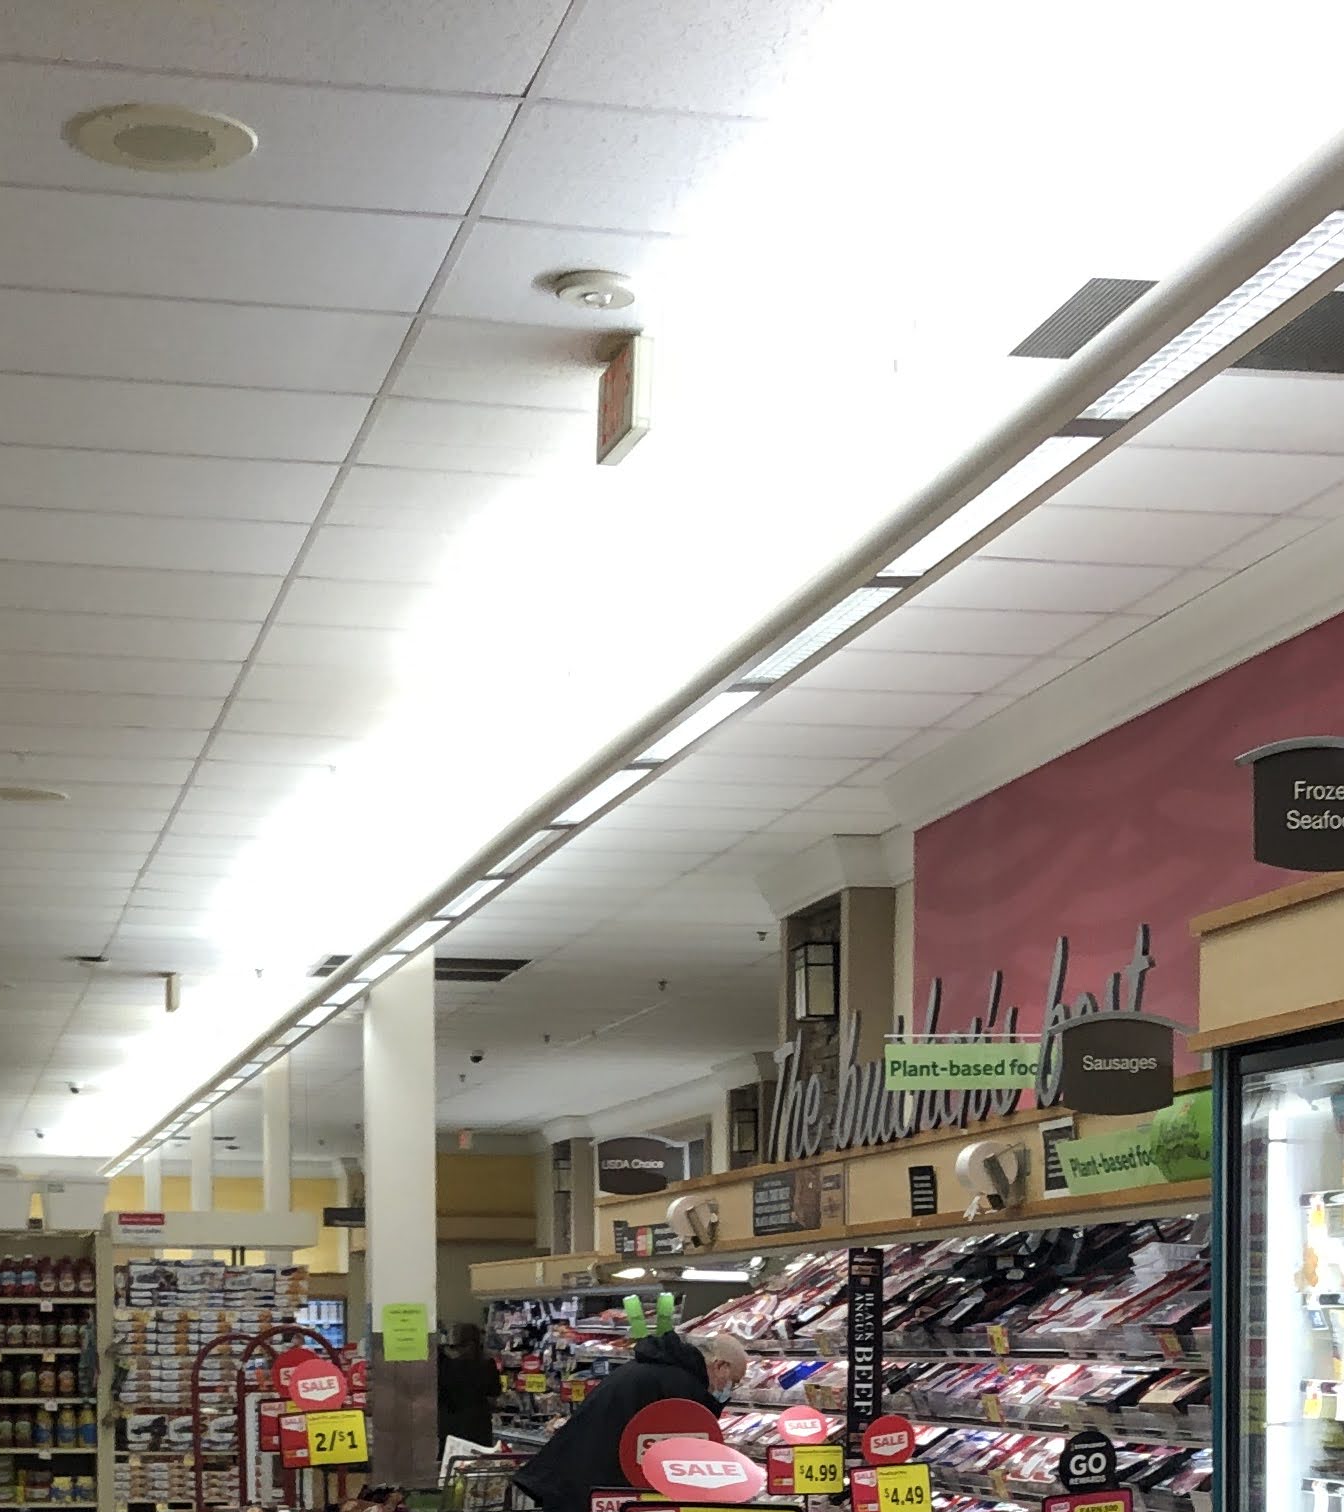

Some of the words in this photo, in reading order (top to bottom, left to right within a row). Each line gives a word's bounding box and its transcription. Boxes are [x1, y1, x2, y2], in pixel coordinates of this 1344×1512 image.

[890, 1059, 1005, 1077] Plant-based
[1009, 1059, 1040, 1077] foo
[1083, 1055, 1157, 1073] Sausages
[768, 1029, 823, 1162] The
[601, 1160, 630, 1169] USDA
[631, 1159, 665, 1169] Choice
[1070, 1146, 1137, 1177] Plant-based
[854, 1293, 864, 1341] ANGUS
[301, 1379, 336, 1392] SALE
[854, 1347, 873, 1416] BEEF
[788, 1421, 818, 1429] SALE
[315, 1430, 358, 1451] 2/$1
[873, 1435, 905, 1446] SALE
[668, 1463, 741, 1476] SALE
[799, 1464, 837, 1482] $4.99
[1070, 1453, 1107, 1475] GO
[885, 1486, 924, 1505] $4.49
[596, 1500, 621, 1512] SAL
